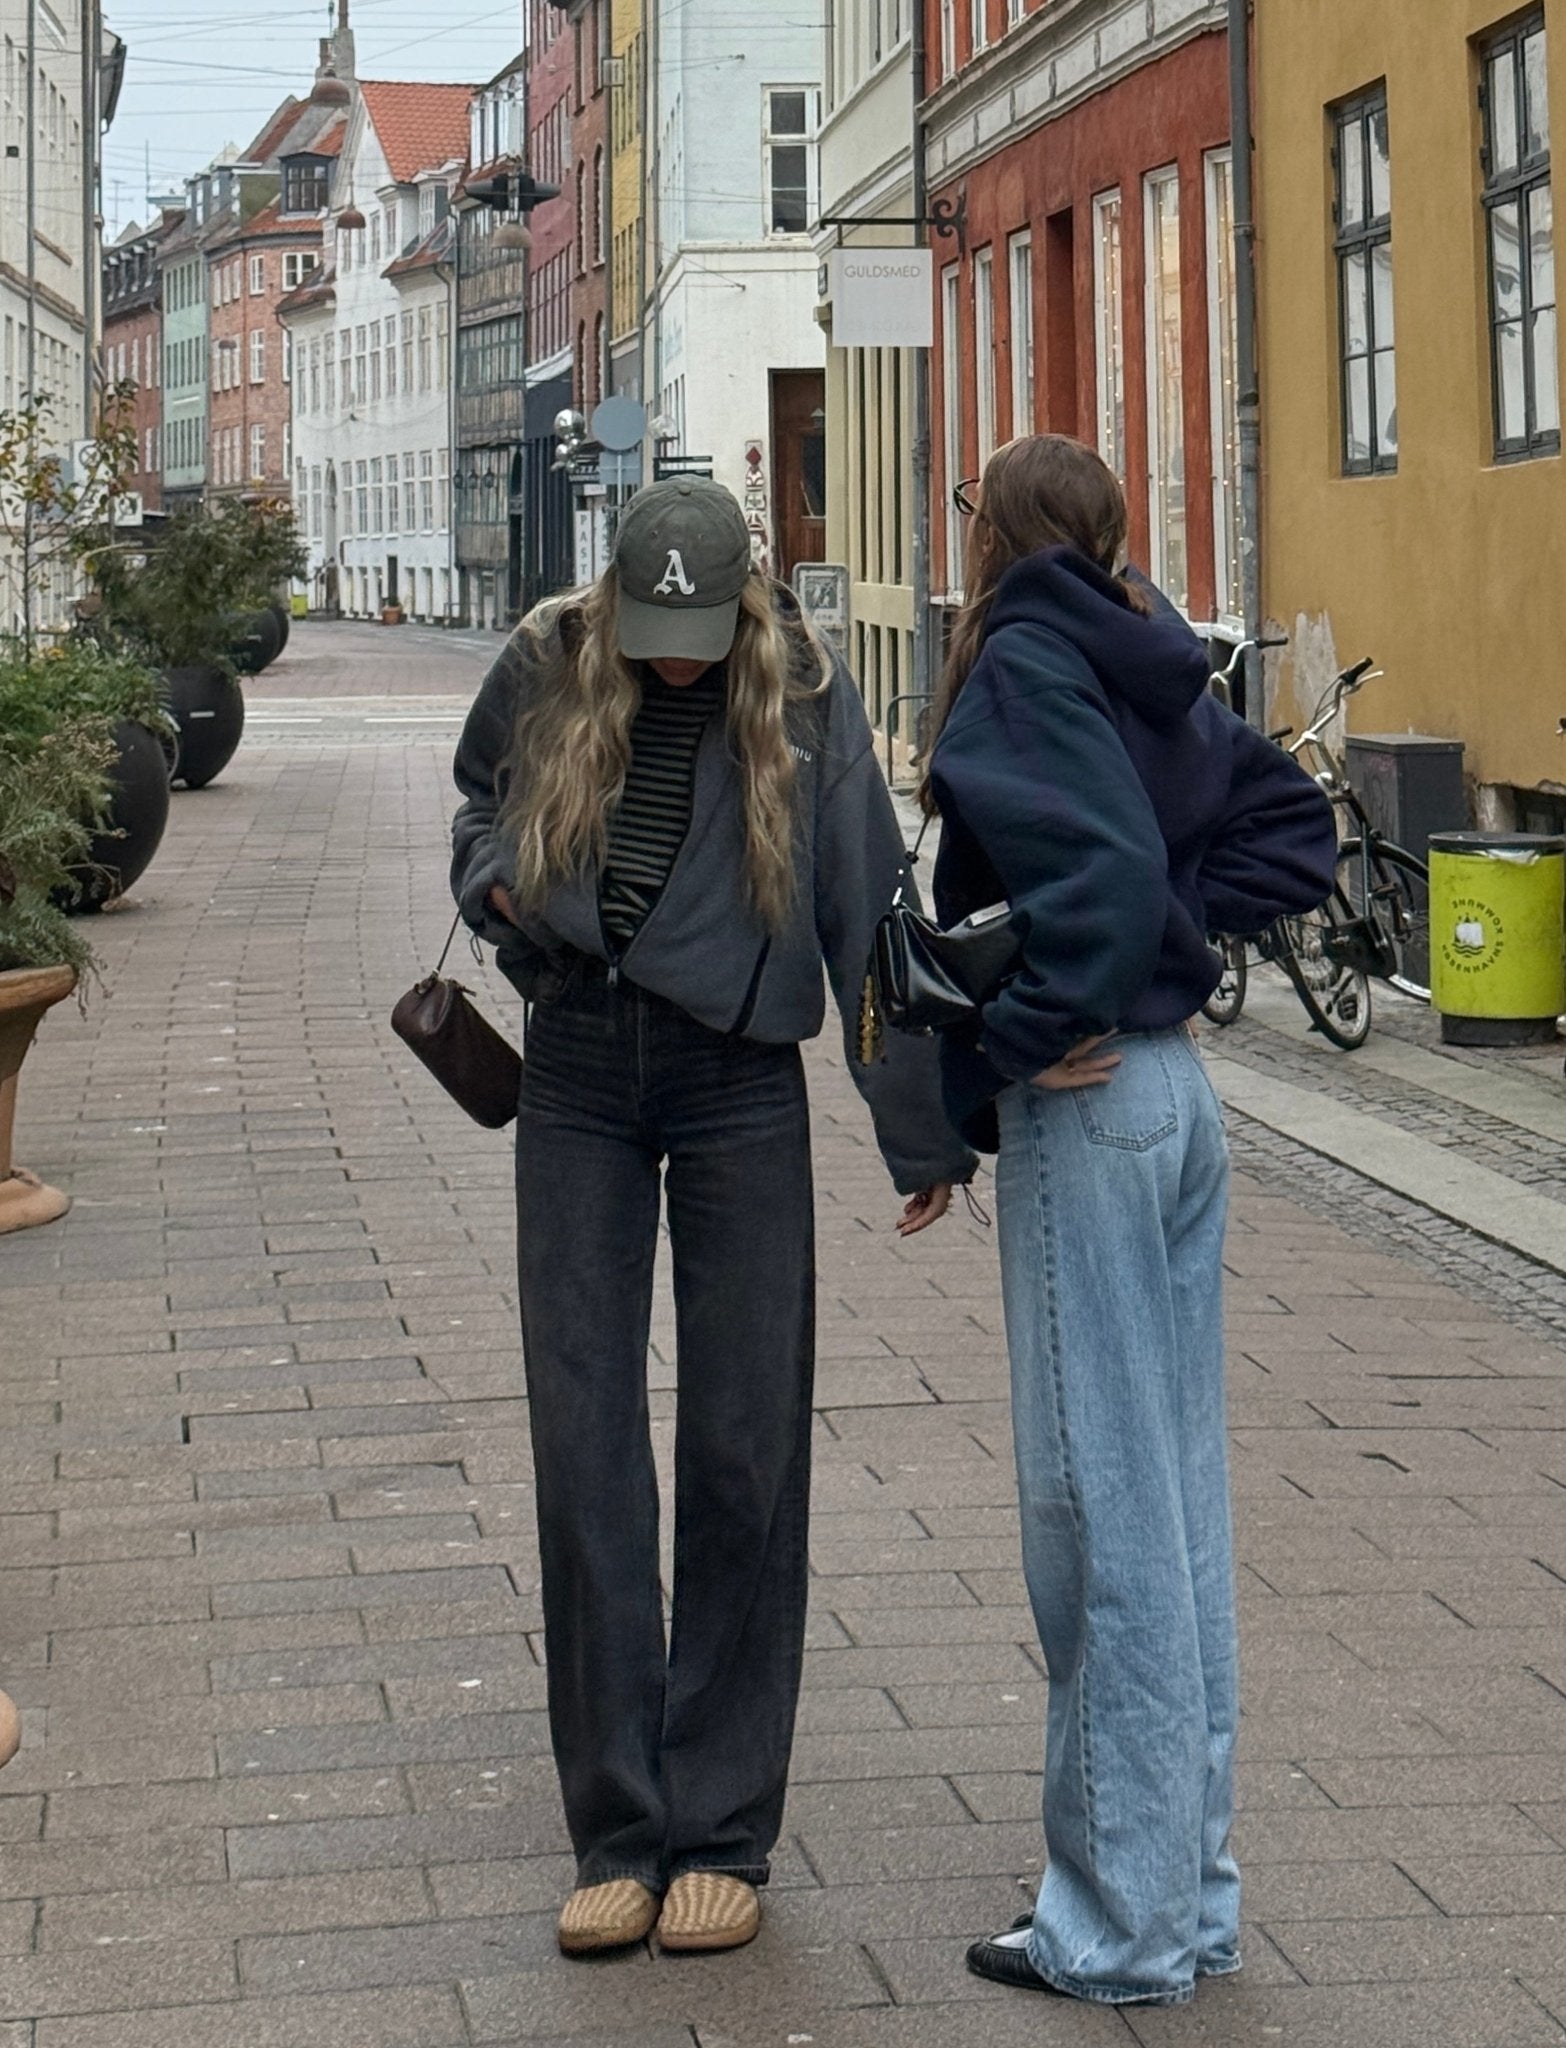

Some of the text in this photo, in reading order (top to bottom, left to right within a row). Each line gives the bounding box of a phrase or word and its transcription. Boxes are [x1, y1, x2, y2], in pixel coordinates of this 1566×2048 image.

[844, 264, 921, 278] GULDSMED
[579, 514, 588, 584] PAST
[653, 549, 695, 595] A
[1442, 898, 1504, 974] KØBENHAVNS KOMMUNE
